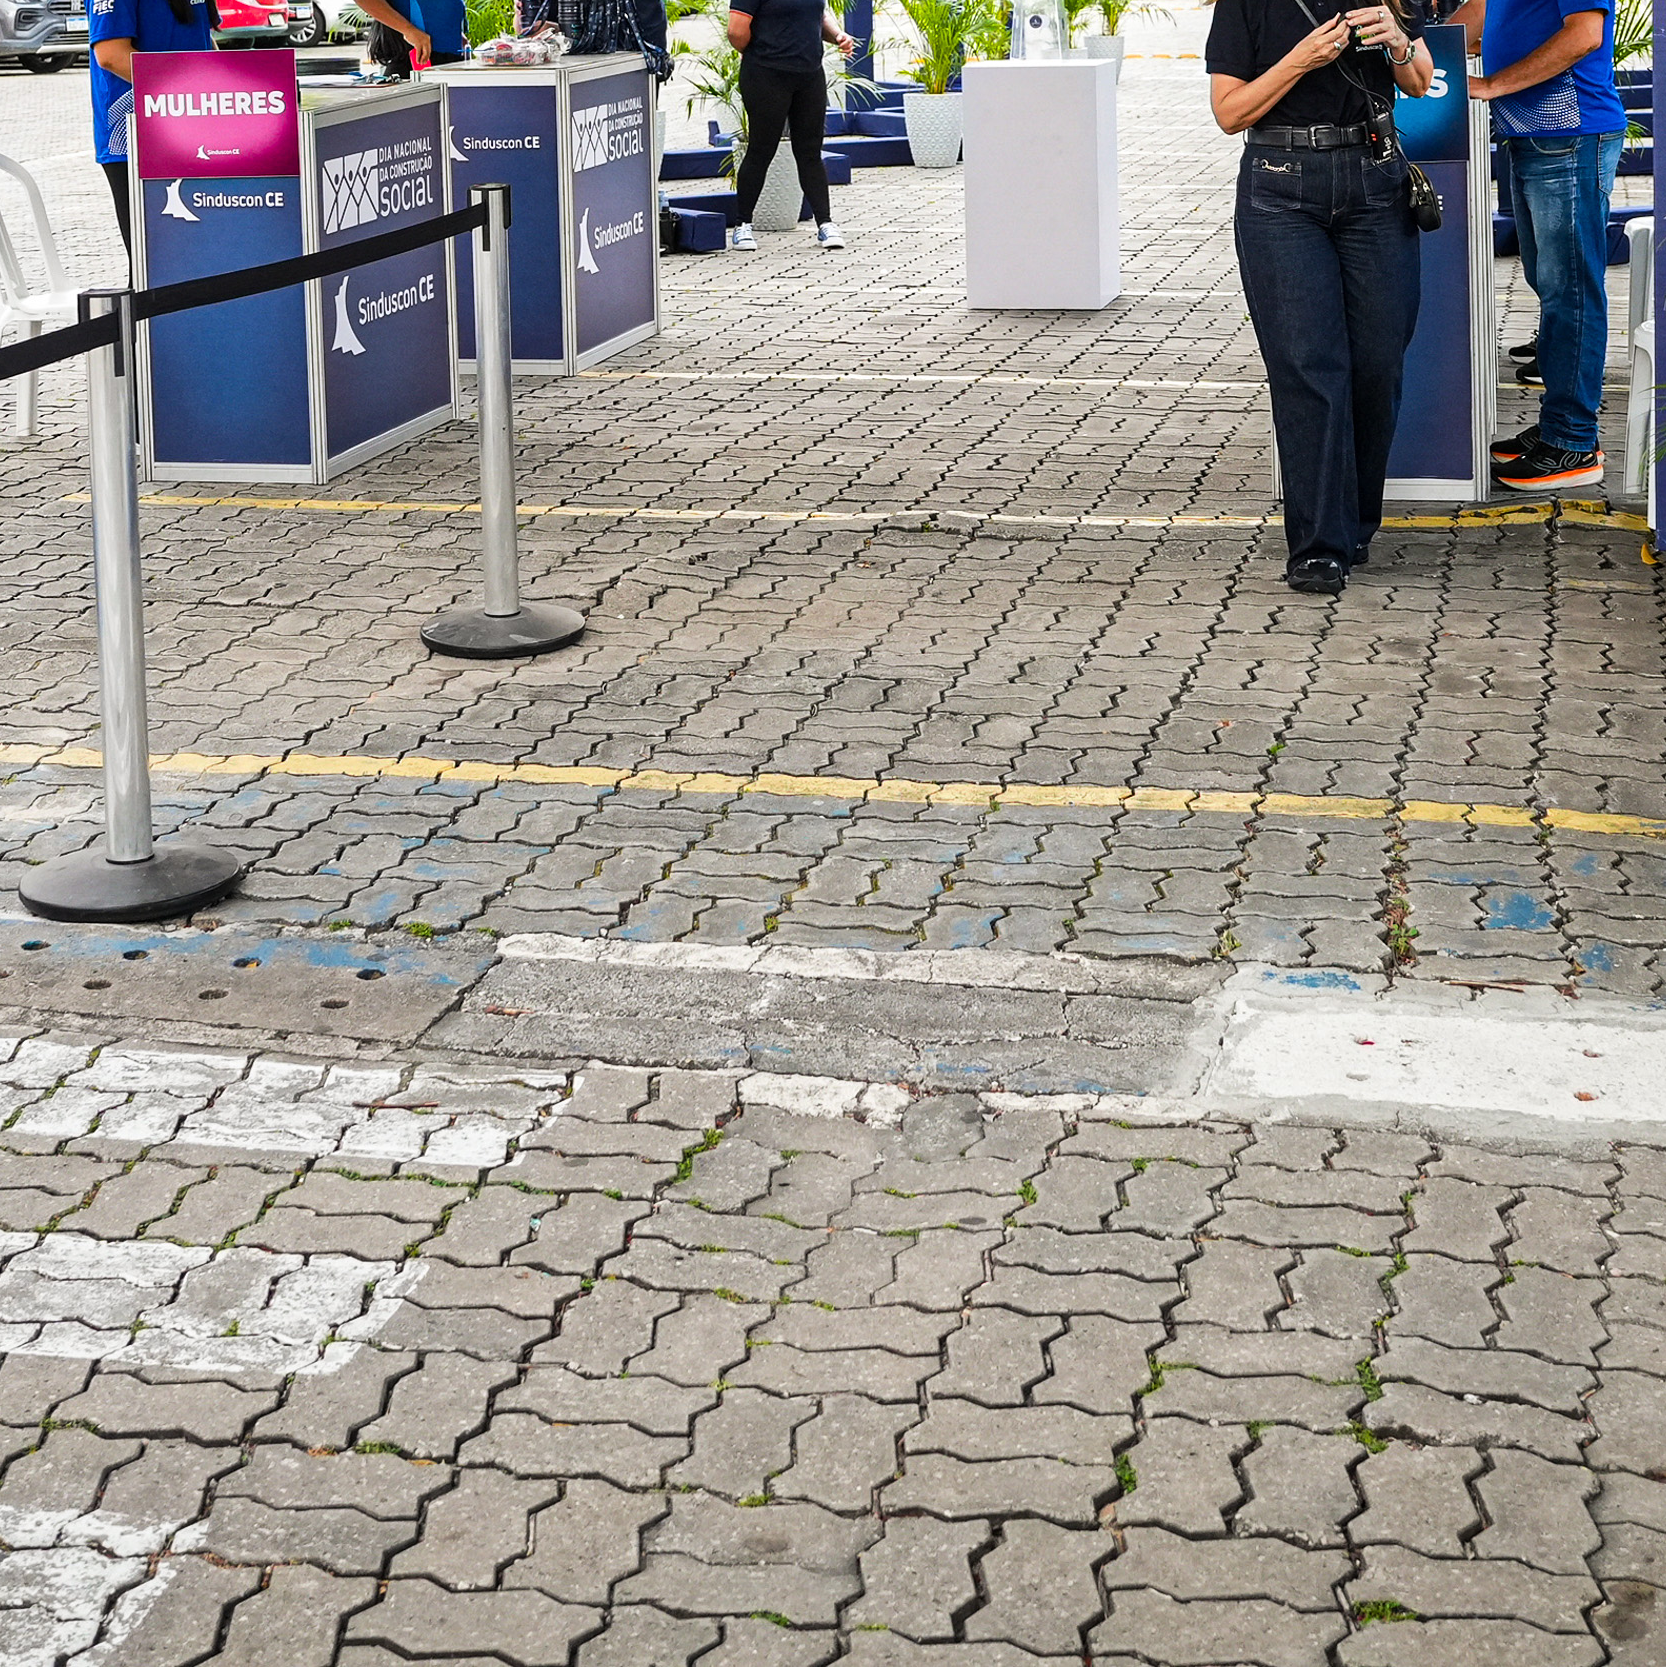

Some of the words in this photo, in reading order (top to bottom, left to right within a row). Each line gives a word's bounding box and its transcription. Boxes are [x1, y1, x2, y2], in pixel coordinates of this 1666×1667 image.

[144, 90, 286, 118] MULHERES
[608, 102, 617, 116] DIA
[617, 96, 643, 114] NACIONAL
[608, 119, 615, 133] DA
[615, 110, 644, 131] CONSTRUÇÃO
[379, 145, 393, 163] DIA
[393, 136, 432, 159] NACIONAL
[463, 137, 523, 150] Sinduscon
[524, 136, 541, 148] CE
[379, 167, 389, 182] DA
[389, 153, 433, 181] CONSTRUÇÃO
[192, 191, 264, 208] Sinduscon
[265, 191, 284, 207] CE
[594, 216, 633, 250] Sinduscon
[633, 211, 644, 234] CE
[358, 285, 418, 325] Sinduscon
[418, 274, 435, 300] CE
